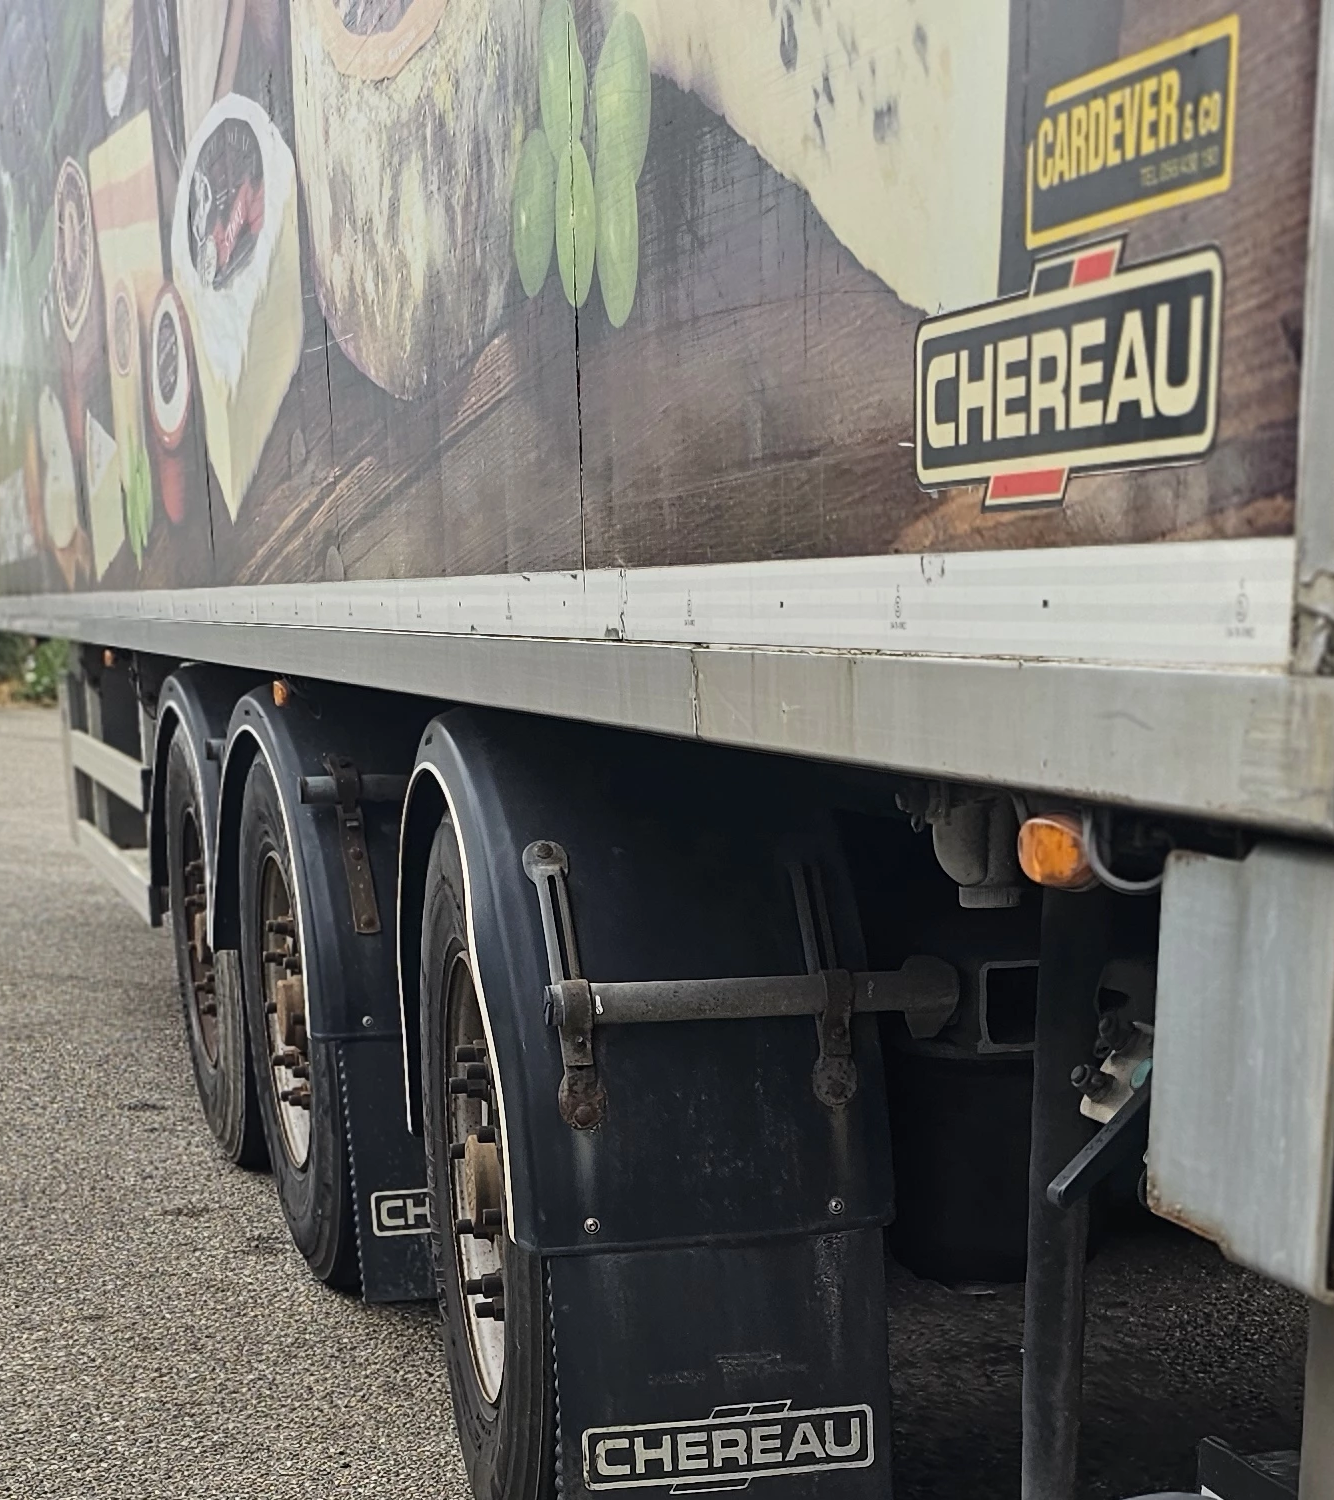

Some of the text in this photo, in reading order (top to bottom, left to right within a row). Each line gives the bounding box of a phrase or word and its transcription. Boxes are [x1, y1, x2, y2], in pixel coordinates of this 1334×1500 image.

[1037, 68, 1181, 191] CARDEVER
[926, 295, 1207, 449] CHEREAU
[595, 1416, 862, 1476] CHEREAU
